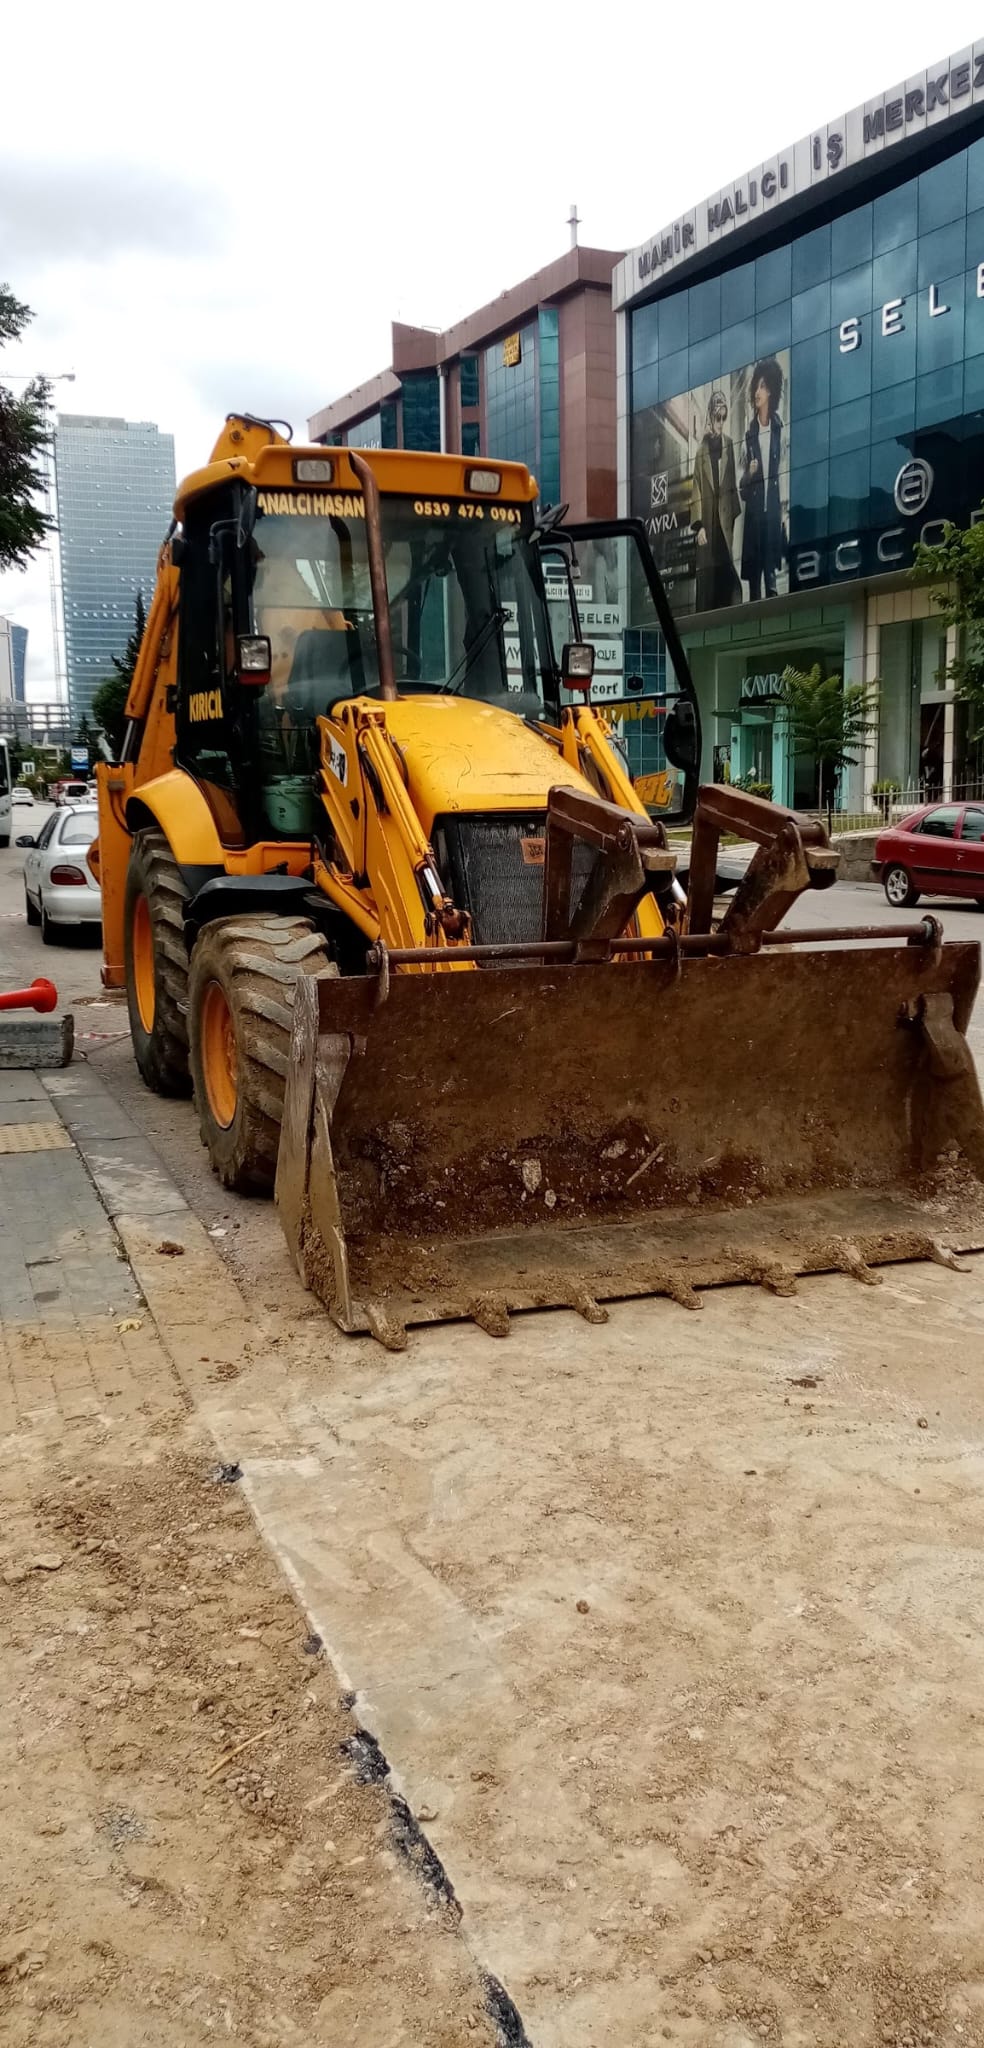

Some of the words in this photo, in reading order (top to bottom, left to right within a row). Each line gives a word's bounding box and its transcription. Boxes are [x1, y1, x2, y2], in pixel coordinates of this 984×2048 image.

[638, 222, 695, 279] MAHİR
[707, 162, 788, 231] HALICI
[813, 132, 843, 170] İŞ
[313, 493, 365, 519] HASAN
[414, 501, 450, 517] 0539
[458, 503, 484, 519] 474
[490, 506, 521, 523] 0961
